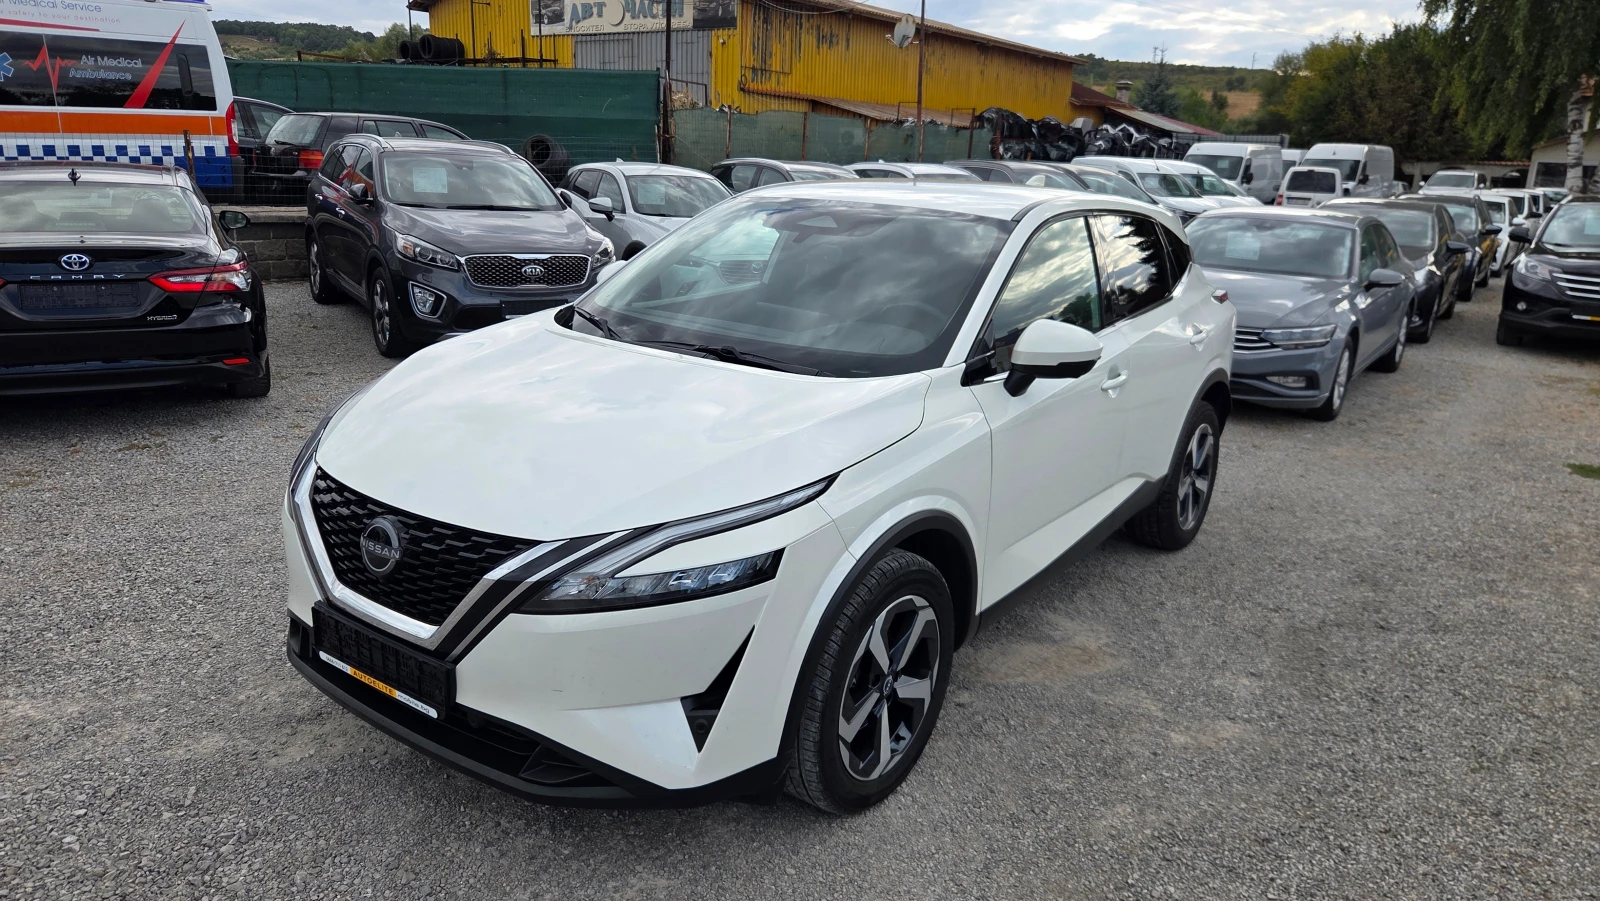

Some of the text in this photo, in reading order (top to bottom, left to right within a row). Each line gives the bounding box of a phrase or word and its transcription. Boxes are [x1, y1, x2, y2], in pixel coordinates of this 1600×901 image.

[61, 1, 101, 12] Service
[650, 20, 693, 29] УПОРЕБА
[80, 54, 143, 68] Air Medical
[69, 67, 132, 81] Ambulance
[361, 537, 400, 559] NISSAN
[353, 670, 395, 696] AUTOELITE
